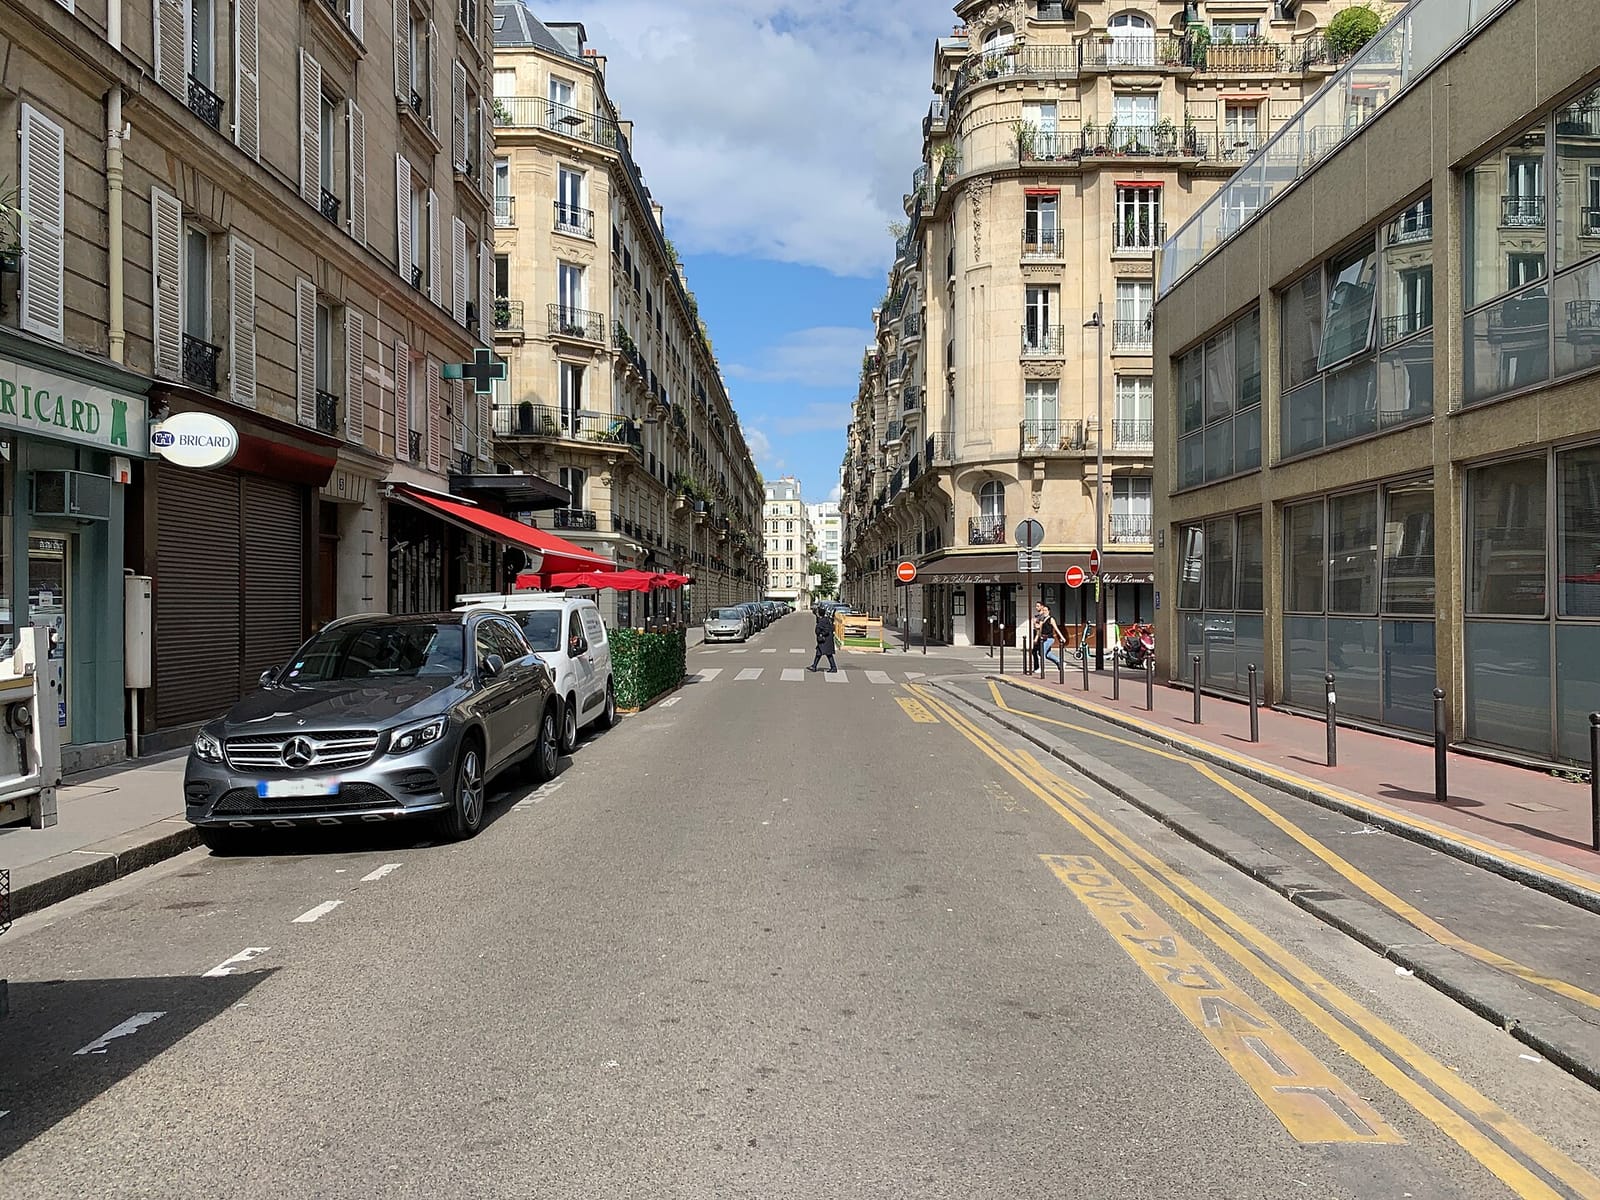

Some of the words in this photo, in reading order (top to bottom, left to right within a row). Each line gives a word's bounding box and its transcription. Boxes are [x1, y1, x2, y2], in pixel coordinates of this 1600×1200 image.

[179, 434, 231, 448] BRICARD
[338, 477, 345, 491] 5
[1048, 853, 1379, 1138] LIVRAISON
